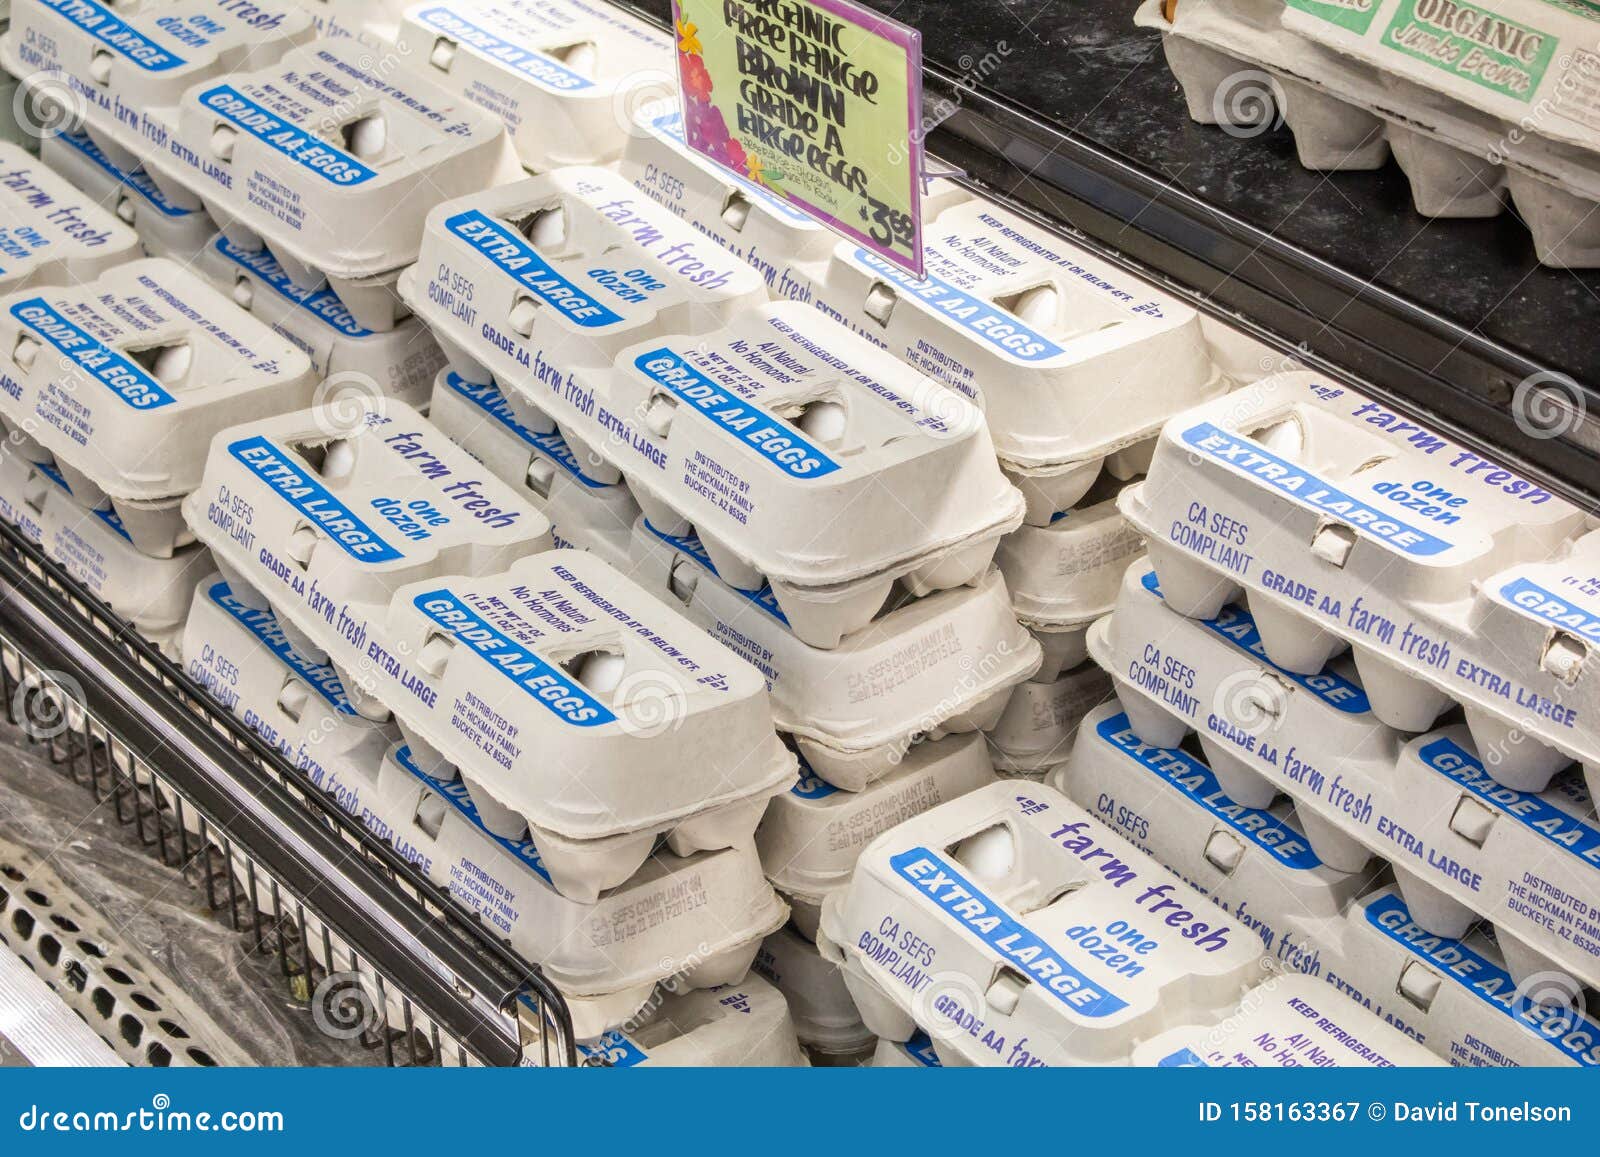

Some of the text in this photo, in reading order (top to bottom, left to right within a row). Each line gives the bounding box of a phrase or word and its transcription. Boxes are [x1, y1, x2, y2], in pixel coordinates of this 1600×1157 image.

[97, 24, 169, 66] LARGE
[155, 16, 210, 48] dozen
[1414, 0, 1543, 63] ORGANIC
[1459, 49, 1530, 91] Brown
[207, 92, 362, 183] GRADE EGGS
[824, 123, 844, 157] A
[644, 163, 685, 199] CA SEFS
[46, 206, 112, 247] fresh
[597, 200, 664, 246] farm
[657, 243, 733, 290] fresh
[943, 235, 961, 247] No
[455, 220, 601, 320] EXTRA LARGE
[978, 214, 1002, 232] KEEP
[1000, 228, 1062, 261] REFRIGERATED
[1082, 273, 1114, 291] BELOW
[987, 246, 1028, 268] Natural
[438, 264, 474, 300] CA SEFS
[587, 267, 648, 304] dozen
[624, 268, 666, 292] one
[939, 289, 1046, 357] AA EGGS
[19, 307, 159, 407] GRADE EGGS
[728, 340, 749, 354] No
[757, 342, 816, 377] All Natural
[768, 317, 793, 333] KEEP
[788, 331, 849, 370] REFRIGERATED
[867, 380, 900, 402] BELOW
[917, 339, 962, 375] DISTRIBUTED
[906, 347, 978, 400] THE FAMILY
[482, 323, 668, 470] GRADE AA farm fresh LARGE
[645, 355, 824, 476] GRADE AA EGGS
[384, 432, 520, 530] farm fresh
[684, 475, 729, 515] BUCKEYE, AZ
[685, 458, 754, 513] THE HICKMAN FAMILY
[694, 450, 750, 495] DISTRIBUTED BY
[1200, 432, 1424, 548] EXTRA LARGE
[1411, 481, 1468, 508] one
[218, 485, 254, 526] CA SEFS
[239, 446, 385, 558] EXTRA LARGE
[370, 497, 432, 541] dozen
[408, 499, 450, 527] one
[1188, 502, 1248, 545] CA SEFS
[1372, 481, 1462, 526] dozen
[1171, 521, 1253, 576] COMPLIANT
[486, 596, 509, 610] NET
[510, 586, 530, 600] No
[538, 590, 596, 625] All Natural
[551, 565, 576, 582] KEEP
[571, 581, 631, 622] REFRIGERATED
[650, 635, 683, 657] BELOW
[259, 548, 291, 583] GRADE
[292, 571, 305, 597] AA
[308, 580, 336, 624] farm
[337, 602, 368, 650] fresh
[367, 640, 402, 679] EXTRA
[401, 669, 438, 709] LARGE
[717, 621, 773, 662] DISTRIBUTED BY
[1262, 569, 1577, 728] GRADE AA farm fresh EXTRA LARGE
[424, 598, 599, 723] GRADE AA EGGS
[1163, 654, 1196, 690] SEFS
[1129, 661, 1200, 719] COMPLIANT
[451, 716, 494, 757] BUCKEYE, AZ
[455, 699, 521, 760] THE HICKMAN FAMILY
[465, 691, 519, 740] DISTRIBUTED BY
[1257, 742, 1482, 893] AA farm fresh EXTRA LARGE
[1431, 753, 1542, 817] GRADE
[1531, 817, 1579, 847] AA
[1117, 806, 1149, 840] SEFS
[1203, 794, 1305, 858] LARGE
[395, 836, 432, 876] LARGE
[460, 857, 515, 903] DISTRIBUTED BY
[463, 872, 520, 923] HICKMAN FAMILY
[1050, 822, 1137, 888] farm
[1135, 885, 1230, 952] fresh
[1523, 872, 1587, 915] DISTRIBUTED
[1508, 898, 1555, 933] BUCKEYE,
[1528, 891, 1573, 924] HICKMAN
[879, 916, 936, 967] CA SEFS
[904, 857, 1101, 1010] EXTRA LARGE
[1066, 924, 1146, 979] dozen
[1105, 920, 1158, 954] one
[1378, 910, 1483, 977] GRADE
[934, 995, 1004, 1054] GRADE AA
[1288, 997, 1319, 1018] KEEP
